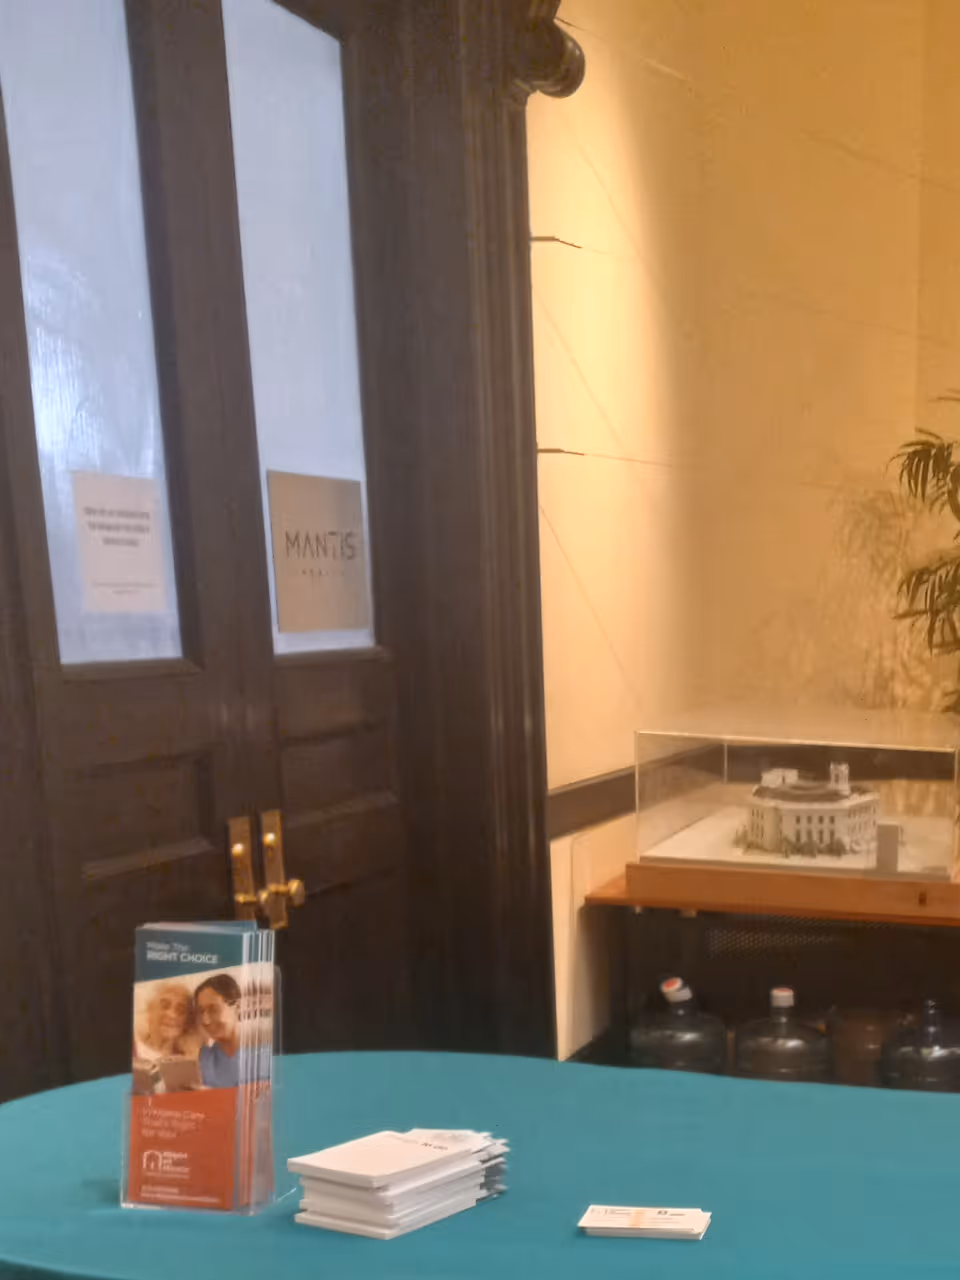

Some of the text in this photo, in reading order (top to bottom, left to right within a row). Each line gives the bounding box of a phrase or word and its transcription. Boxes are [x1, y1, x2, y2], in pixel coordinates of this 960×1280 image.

[285, 529, 355, 560] MANTIS
[146, 950, 218, 965] RIGHT CHOICE
